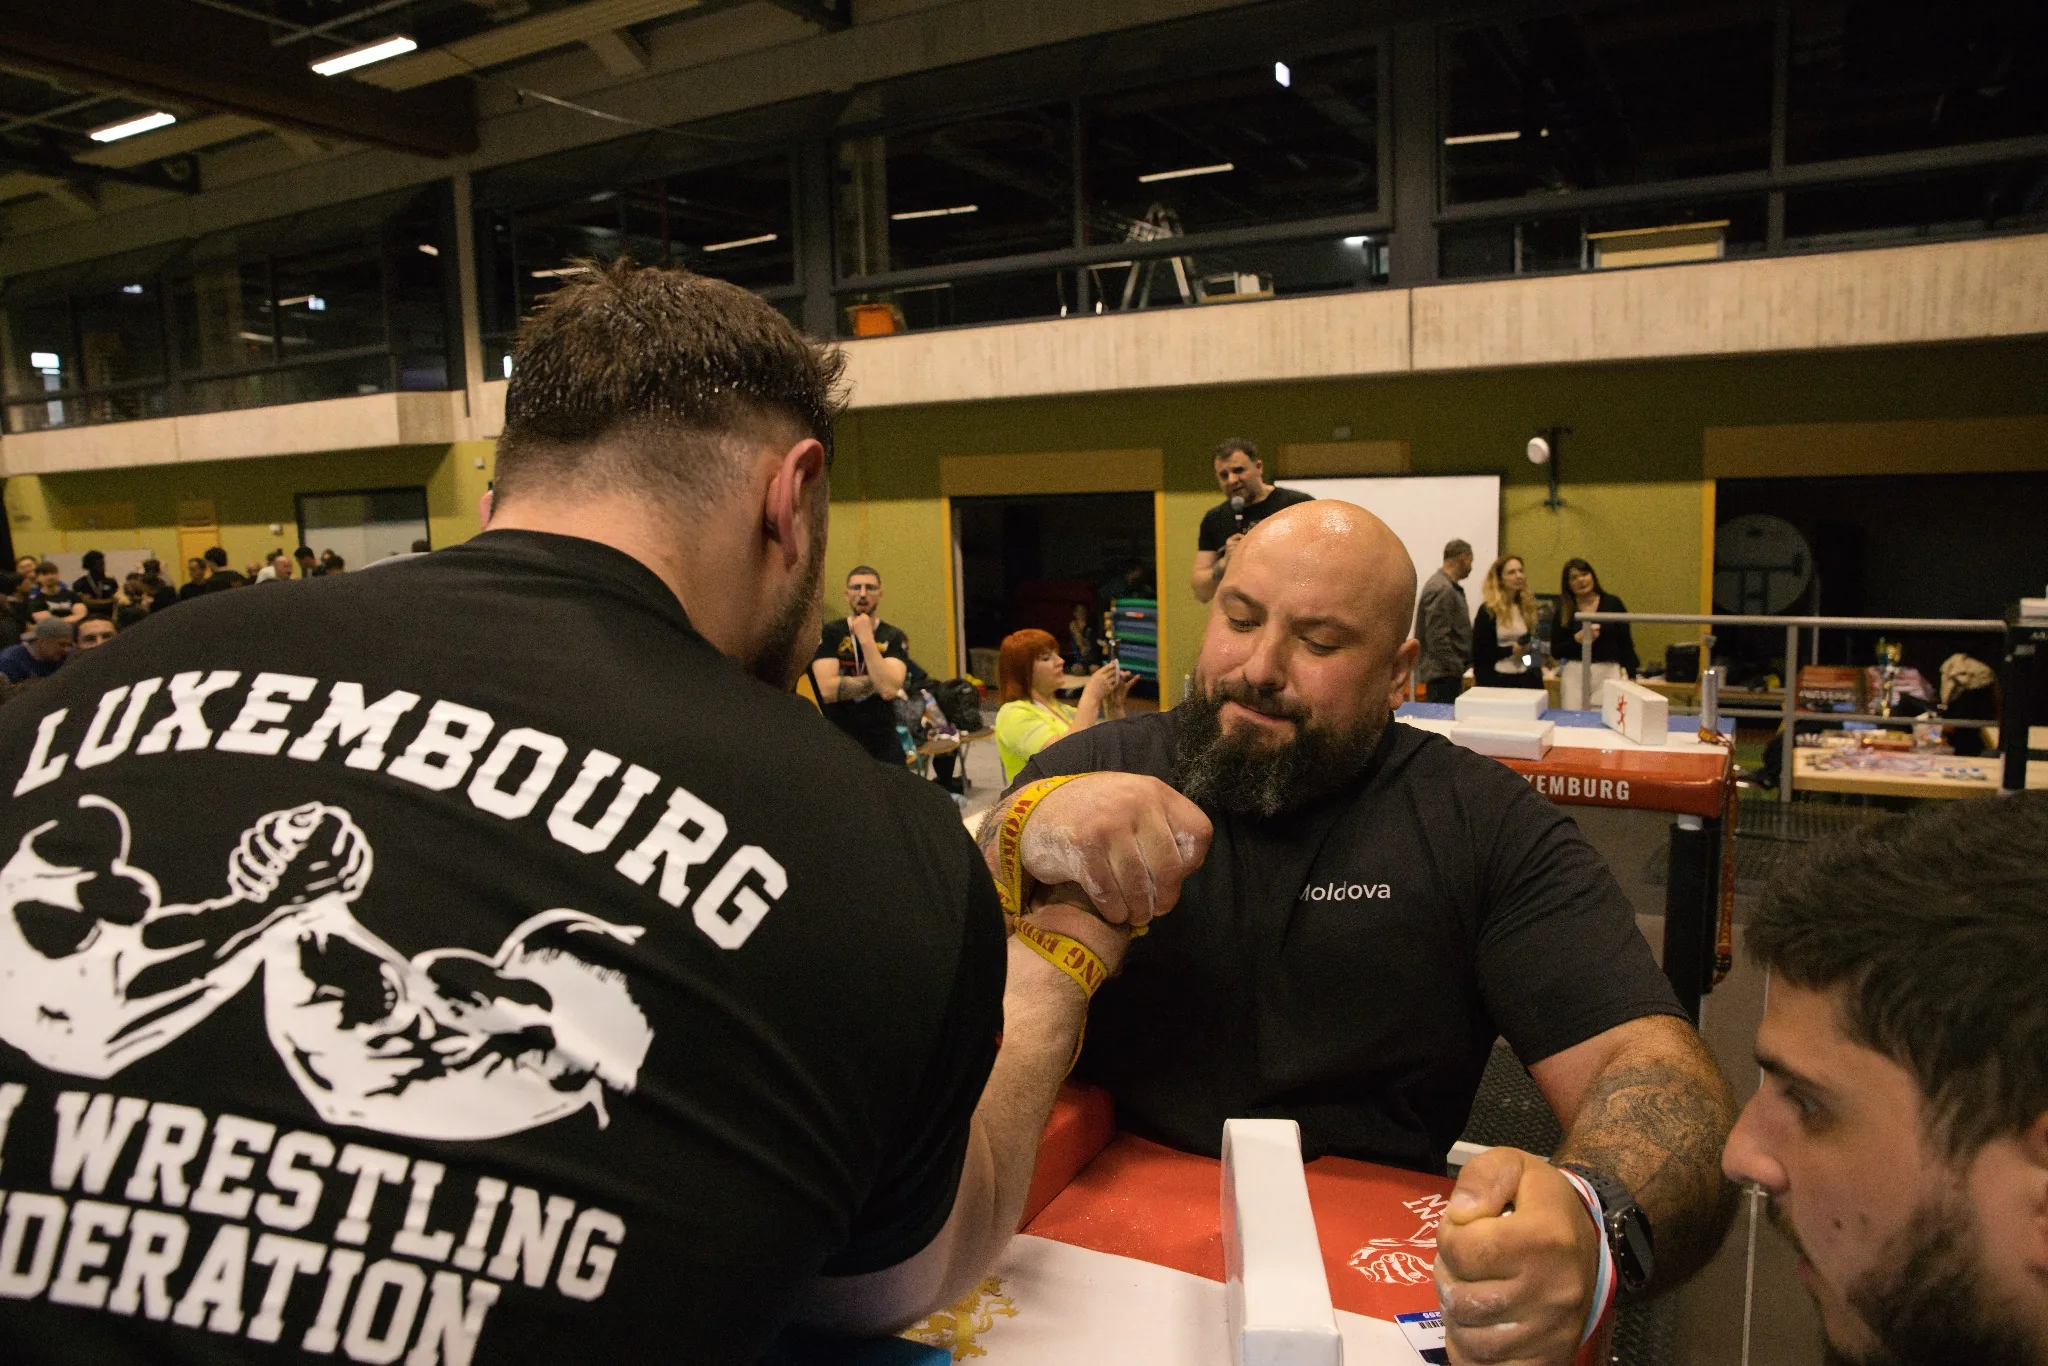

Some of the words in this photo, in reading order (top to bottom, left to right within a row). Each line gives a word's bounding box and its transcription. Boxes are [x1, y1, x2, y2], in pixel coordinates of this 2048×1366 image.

[14, 670, 788, 949] LUXEMBOURG
[0, 1189, 500, 1366] DERATION
[50, 1090, 626, 1302] WRESTLING
